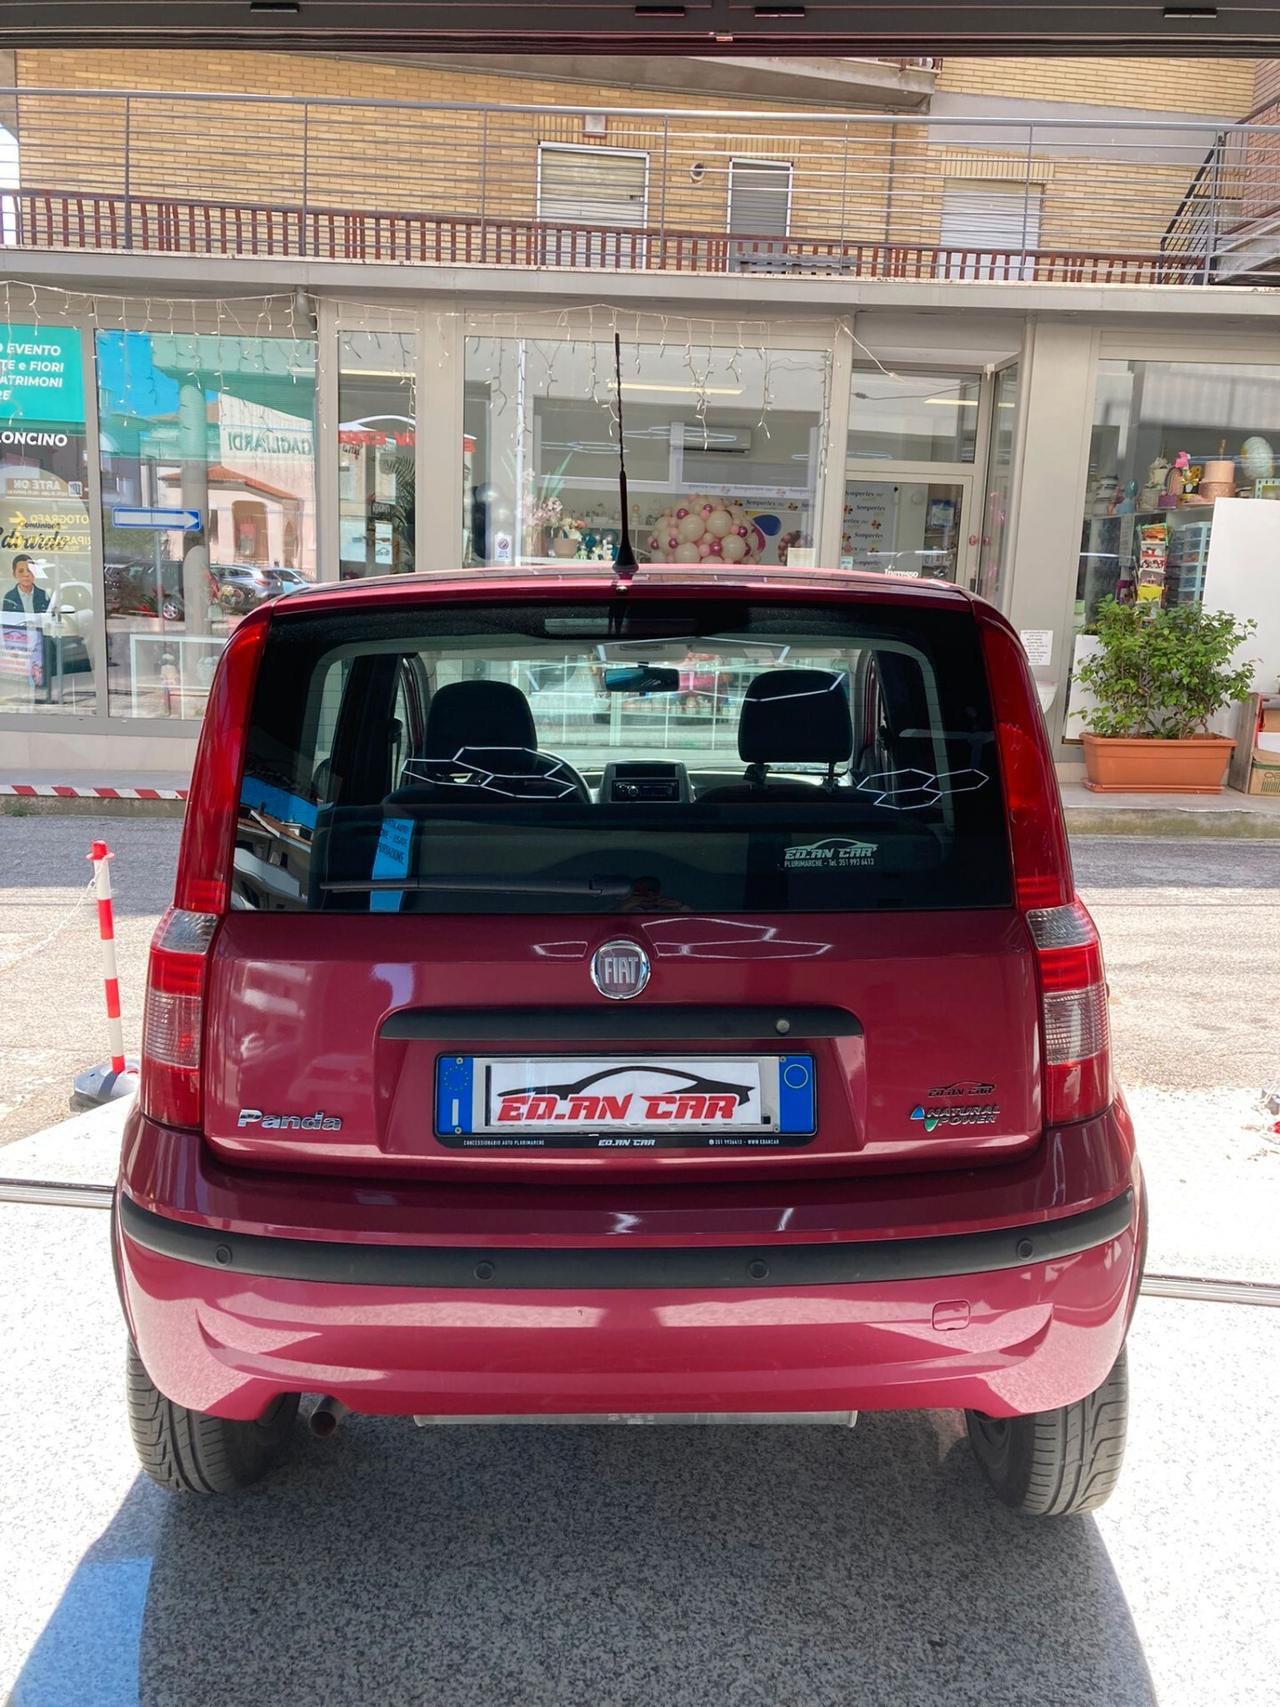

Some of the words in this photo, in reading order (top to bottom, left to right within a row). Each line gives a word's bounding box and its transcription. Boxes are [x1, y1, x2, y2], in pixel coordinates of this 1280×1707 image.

[7, 343, 61, 356] EVENTO
[18, 362, 26, 370] e
[29, 361, 64, 372] FIORI
[0, 431, 68, 446] ONCINO
[784, 848, 835, 860] ED.AN
[838, 848, 873, 857] CAR
[604, 956, 639, 984] FIAT
[497, 1092, 634, 1122] ED.AN
[640, 1094, 740, 1120] CAR
[926, 1104, 1001, 1118] NATURAL
[237, 1109, 342, 1131] Panda
[938, 1115, 997, 1126] POWER
[598, 1139, 631, 1147] ED.AN
